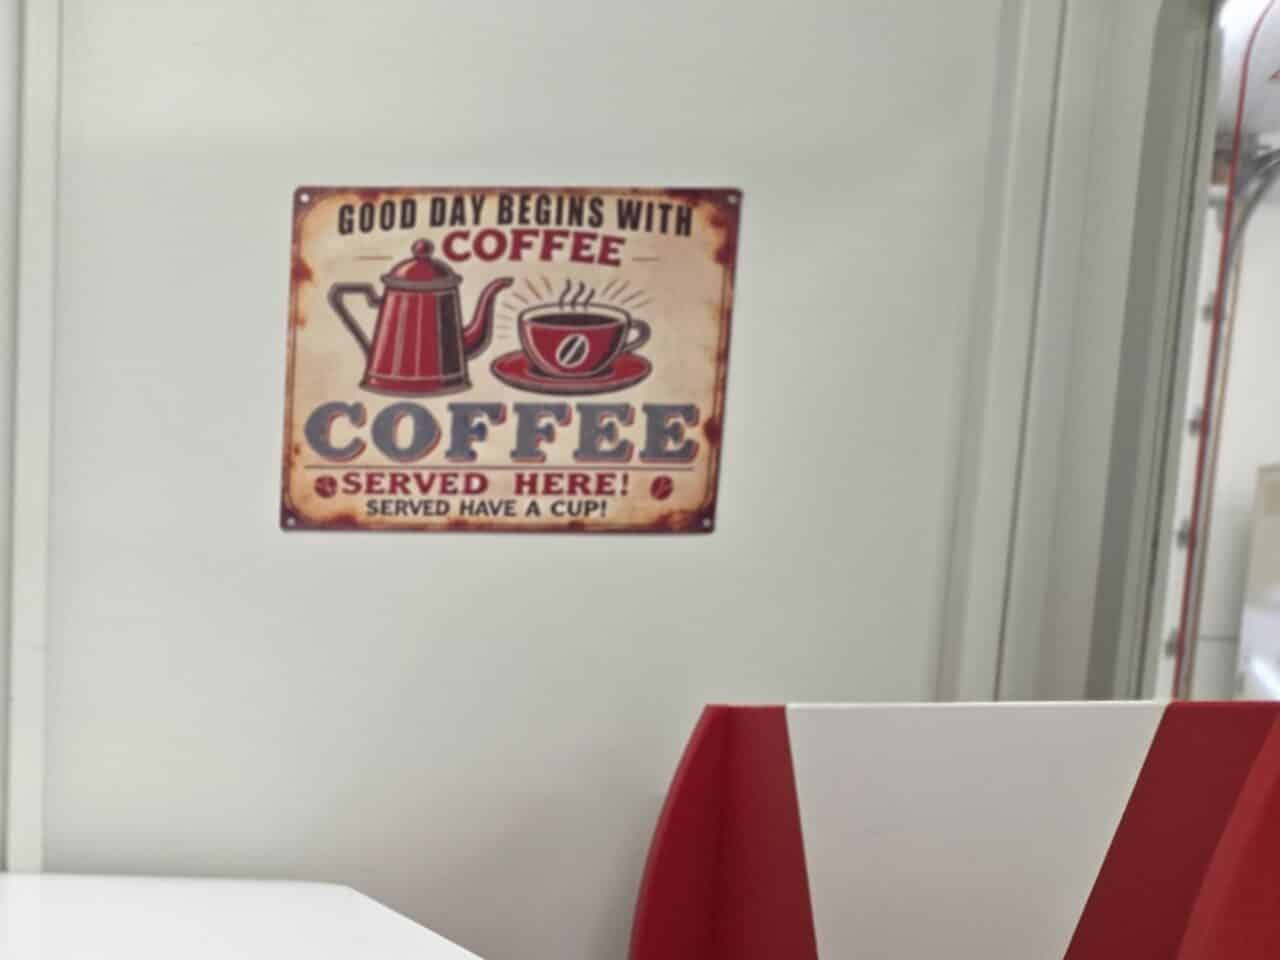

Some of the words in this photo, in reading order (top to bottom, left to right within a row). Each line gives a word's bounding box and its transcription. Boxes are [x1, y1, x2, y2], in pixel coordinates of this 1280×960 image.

[338, 201, 417, 235] GOOD
[429, 197, 487, 226] DAY
[497, 195, 604, 228] BEGINS
[617, 199, 693, 237] WITH
[441, 228, 626, 267] COFFEE
[303, 401, 701, 465] COFFEE
[341, 472, 489, 497] SERVED
[513, 472, 630, 497] HERE!
[365, 499, 451, 518] SERVED
[459, 499, 517, 518] HAVE
[525, 499, 541, 518] A
[550, 499, 608, 518] CUP!
